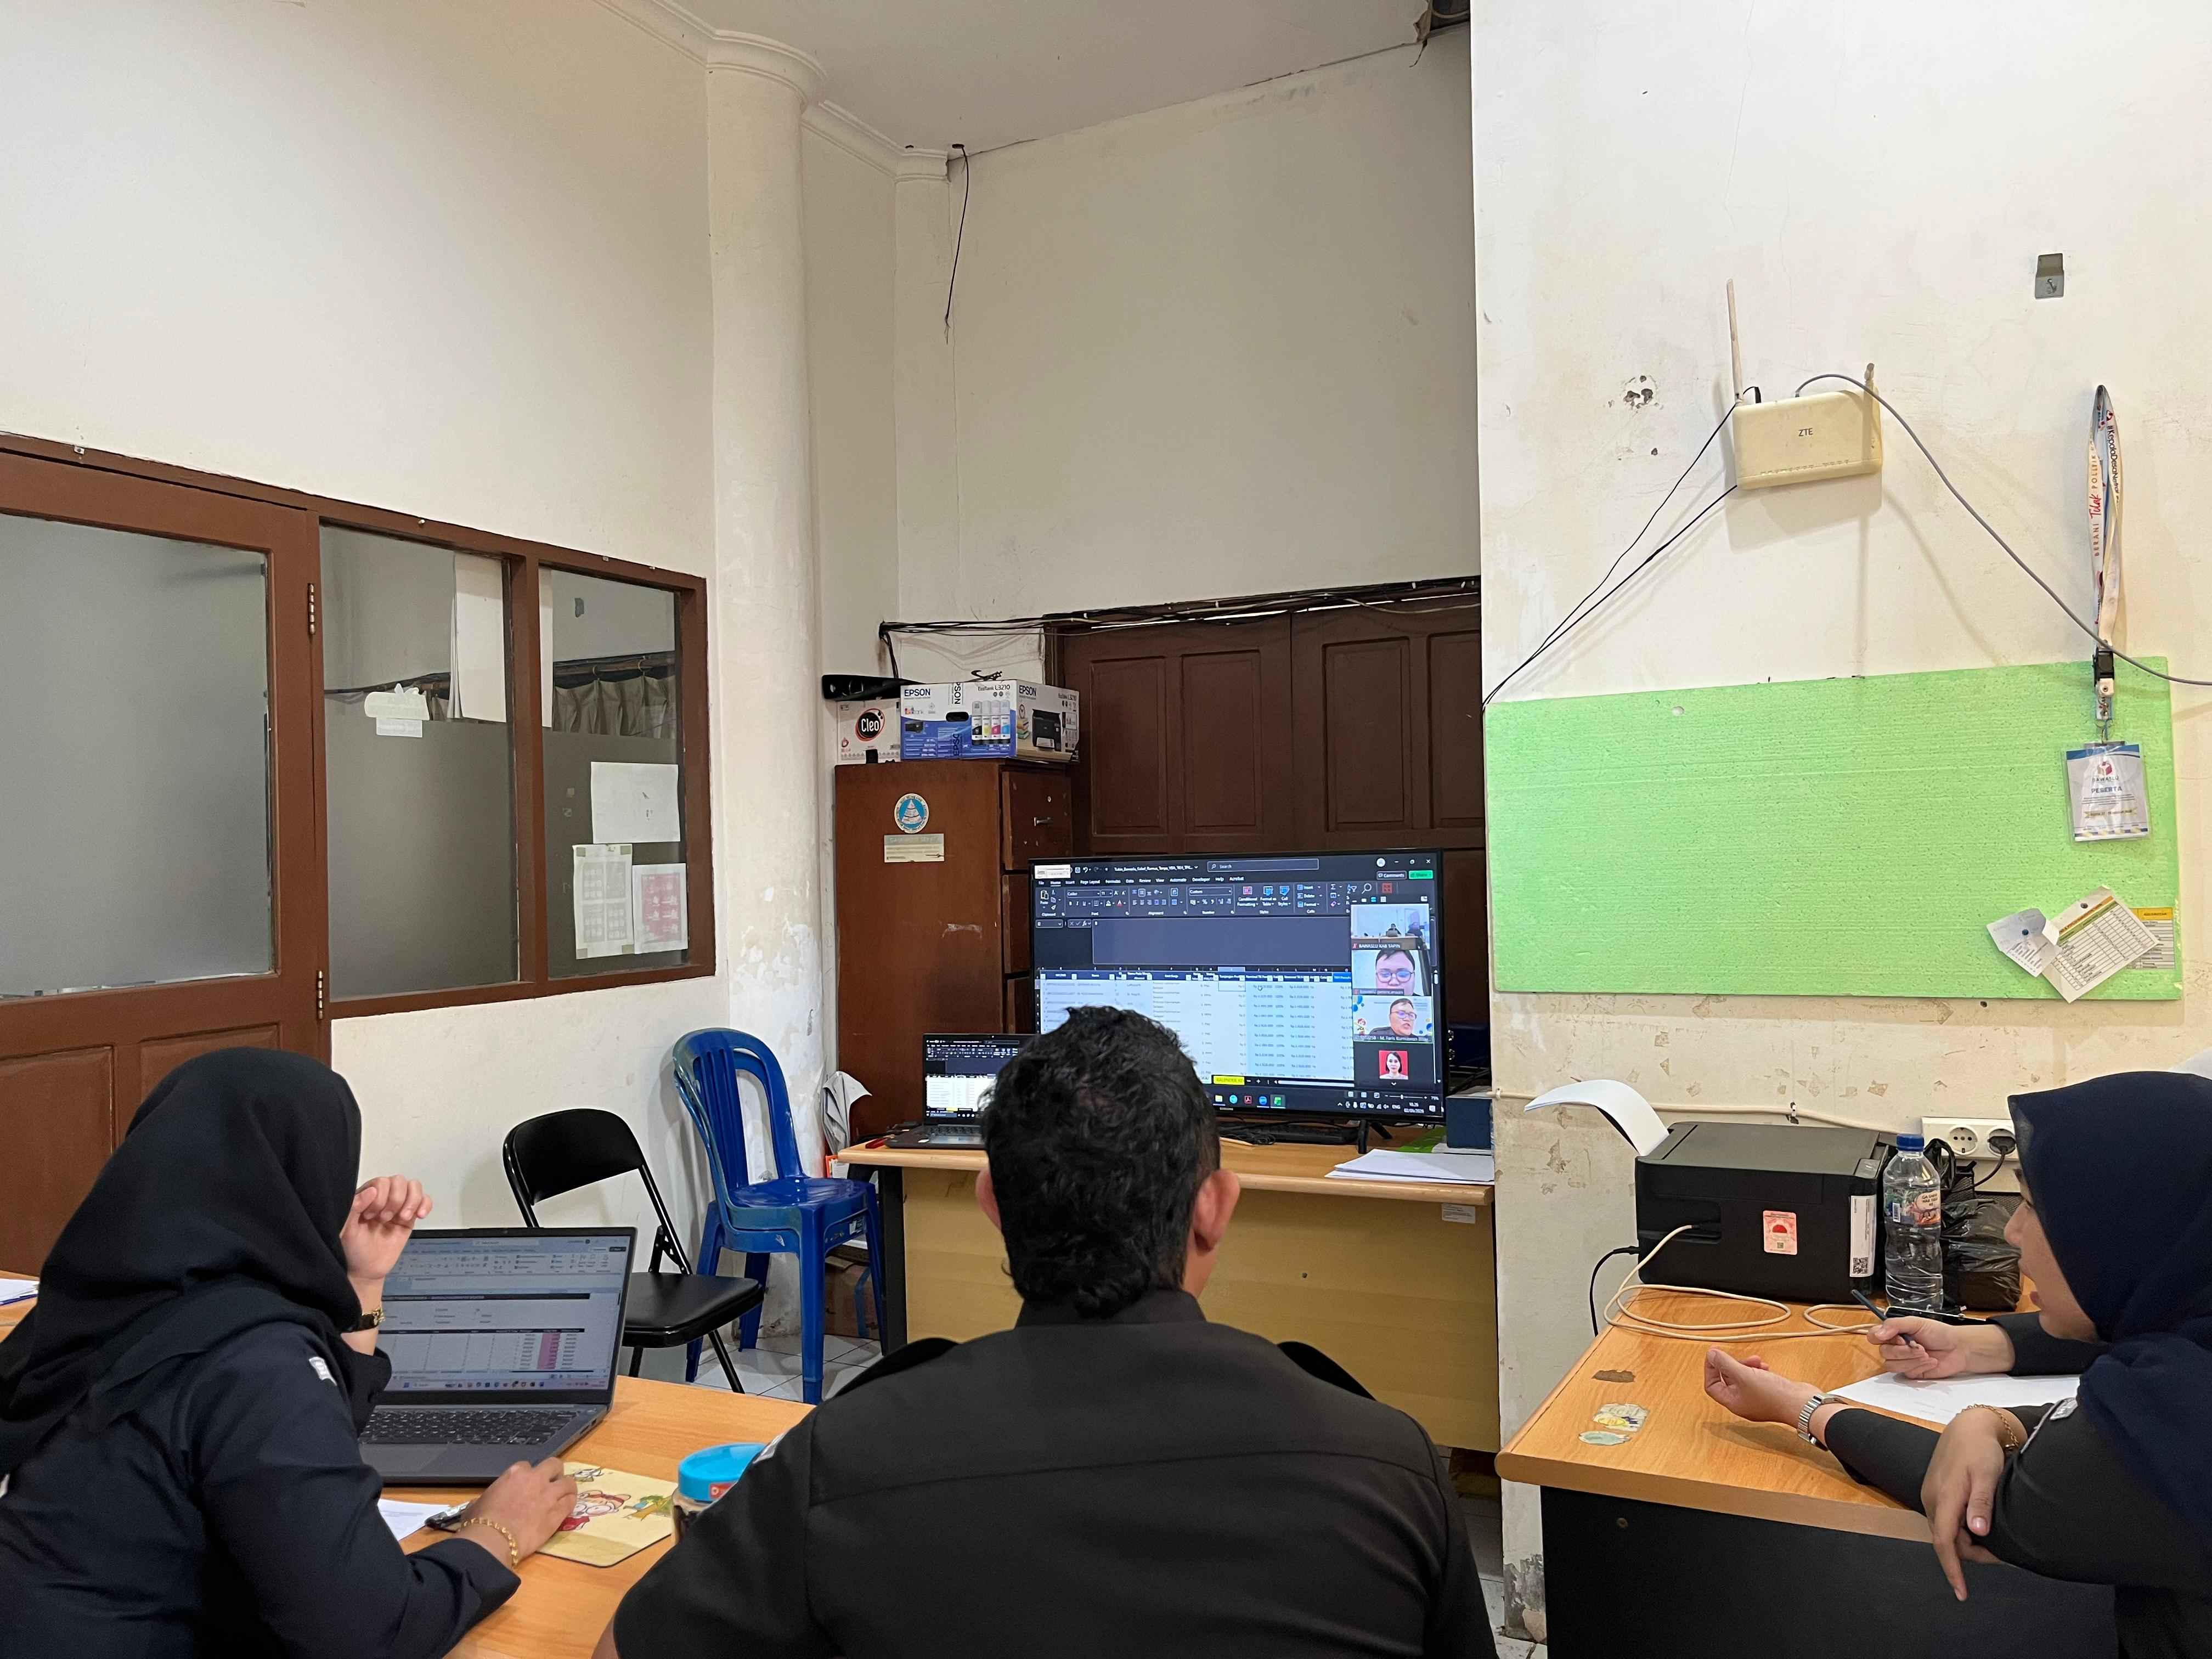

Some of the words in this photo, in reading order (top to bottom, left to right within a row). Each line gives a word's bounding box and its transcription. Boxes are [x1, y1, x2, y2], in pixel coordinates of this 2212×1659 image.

[1798, 428, 1813, 437] ZTE
[904, 689, 930, 697] EPSON
[1019, 685, 1036, 696] EPSON
[861, 718, 879, 732] Cleo
